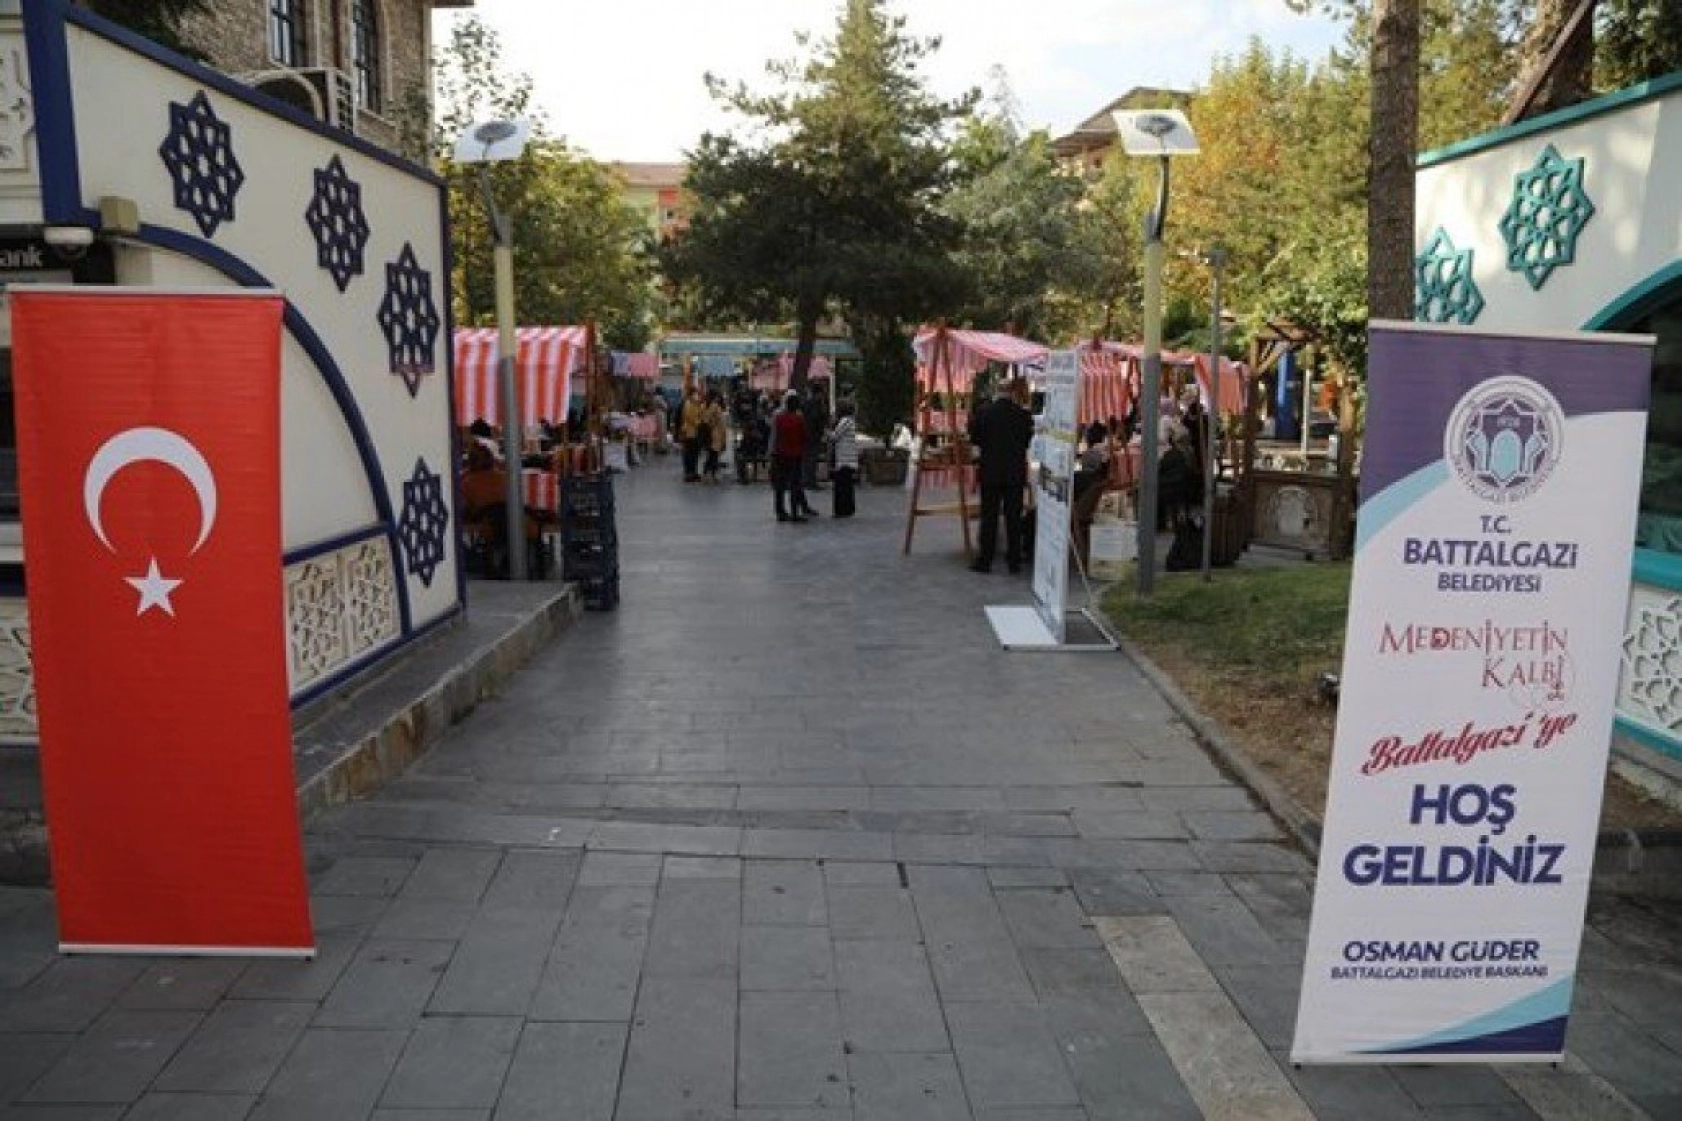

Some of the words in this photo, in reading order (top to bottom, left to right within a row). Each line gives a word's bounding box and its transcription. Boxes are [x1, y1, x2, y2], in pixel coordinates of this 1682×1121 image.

[1479, 514, 1512, 534] T.C.
[1410, 783, 1517, 836] HOŞ
[1343, 834, 1566, 887] GELDİNİZ
[1344, 940, 1445, 962] OSMAN
